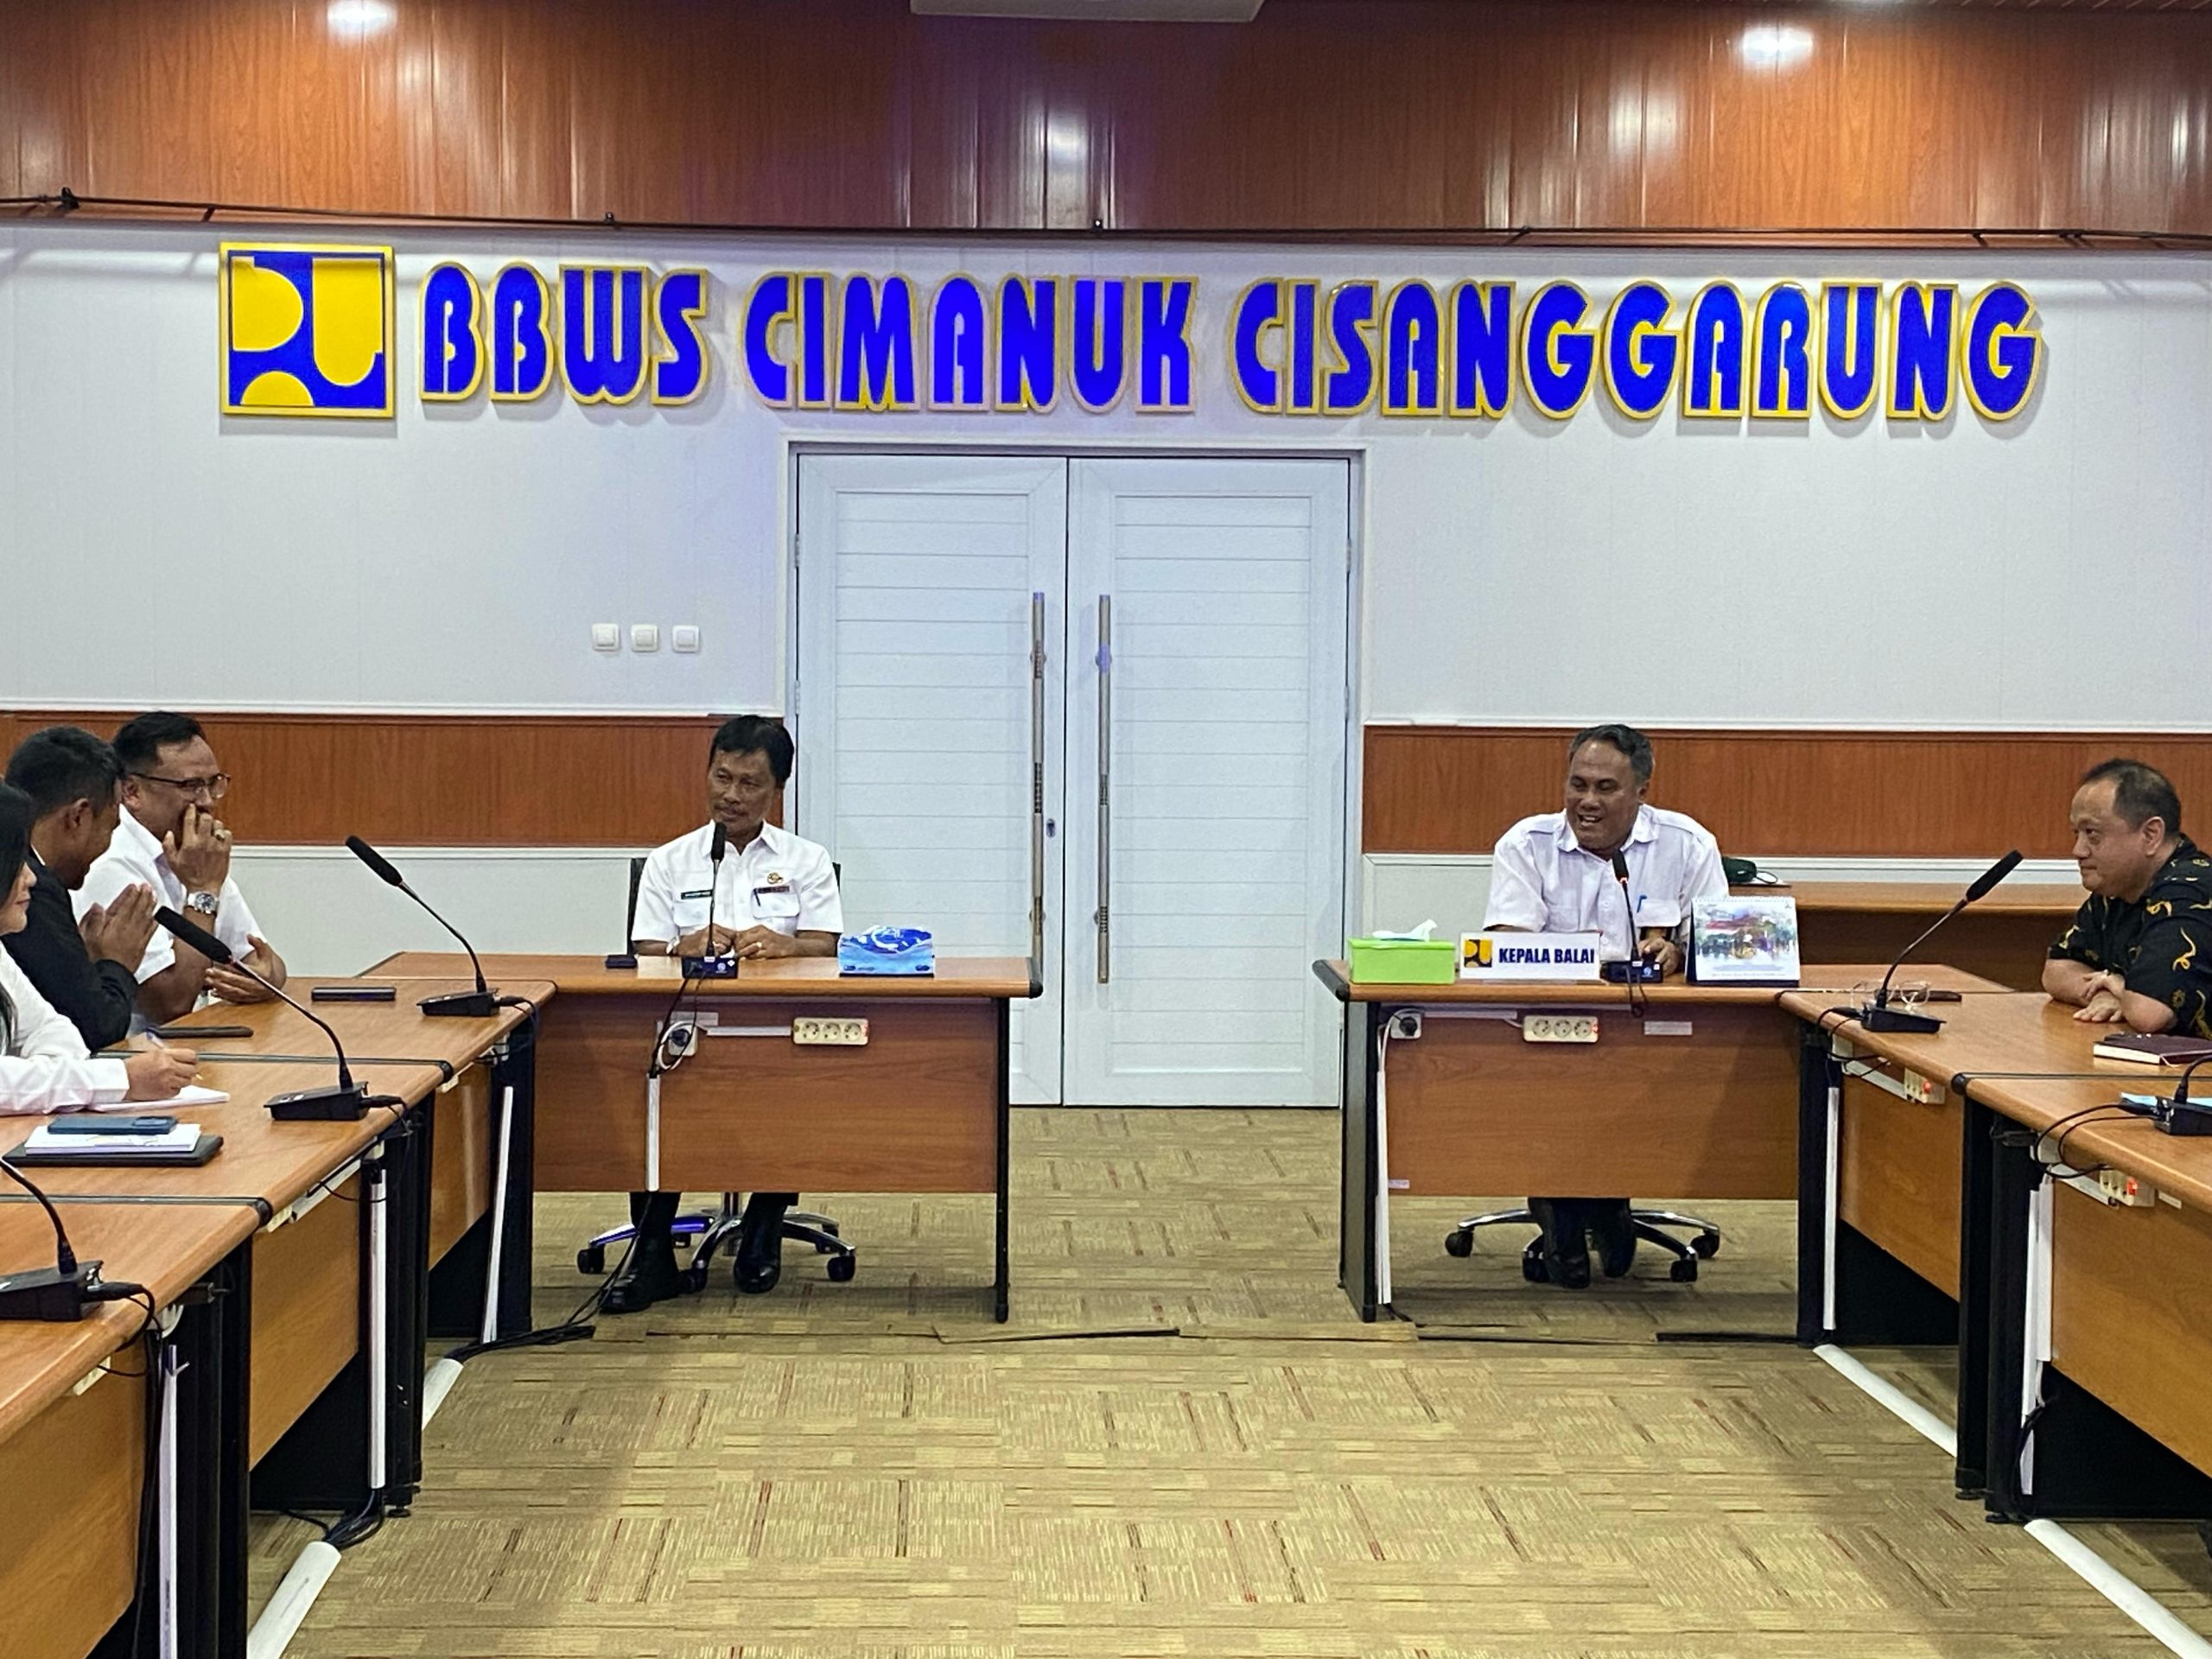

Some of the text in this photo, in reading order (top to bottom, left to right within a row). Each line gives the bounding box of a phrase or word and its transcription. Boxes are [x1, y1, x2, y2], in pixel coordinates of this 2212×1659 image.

[420, 262, 2042, 420] BBWS CIMANUK CISANGGARUNG
[1498, 948, 1595, 963] KEPALA BALAI
